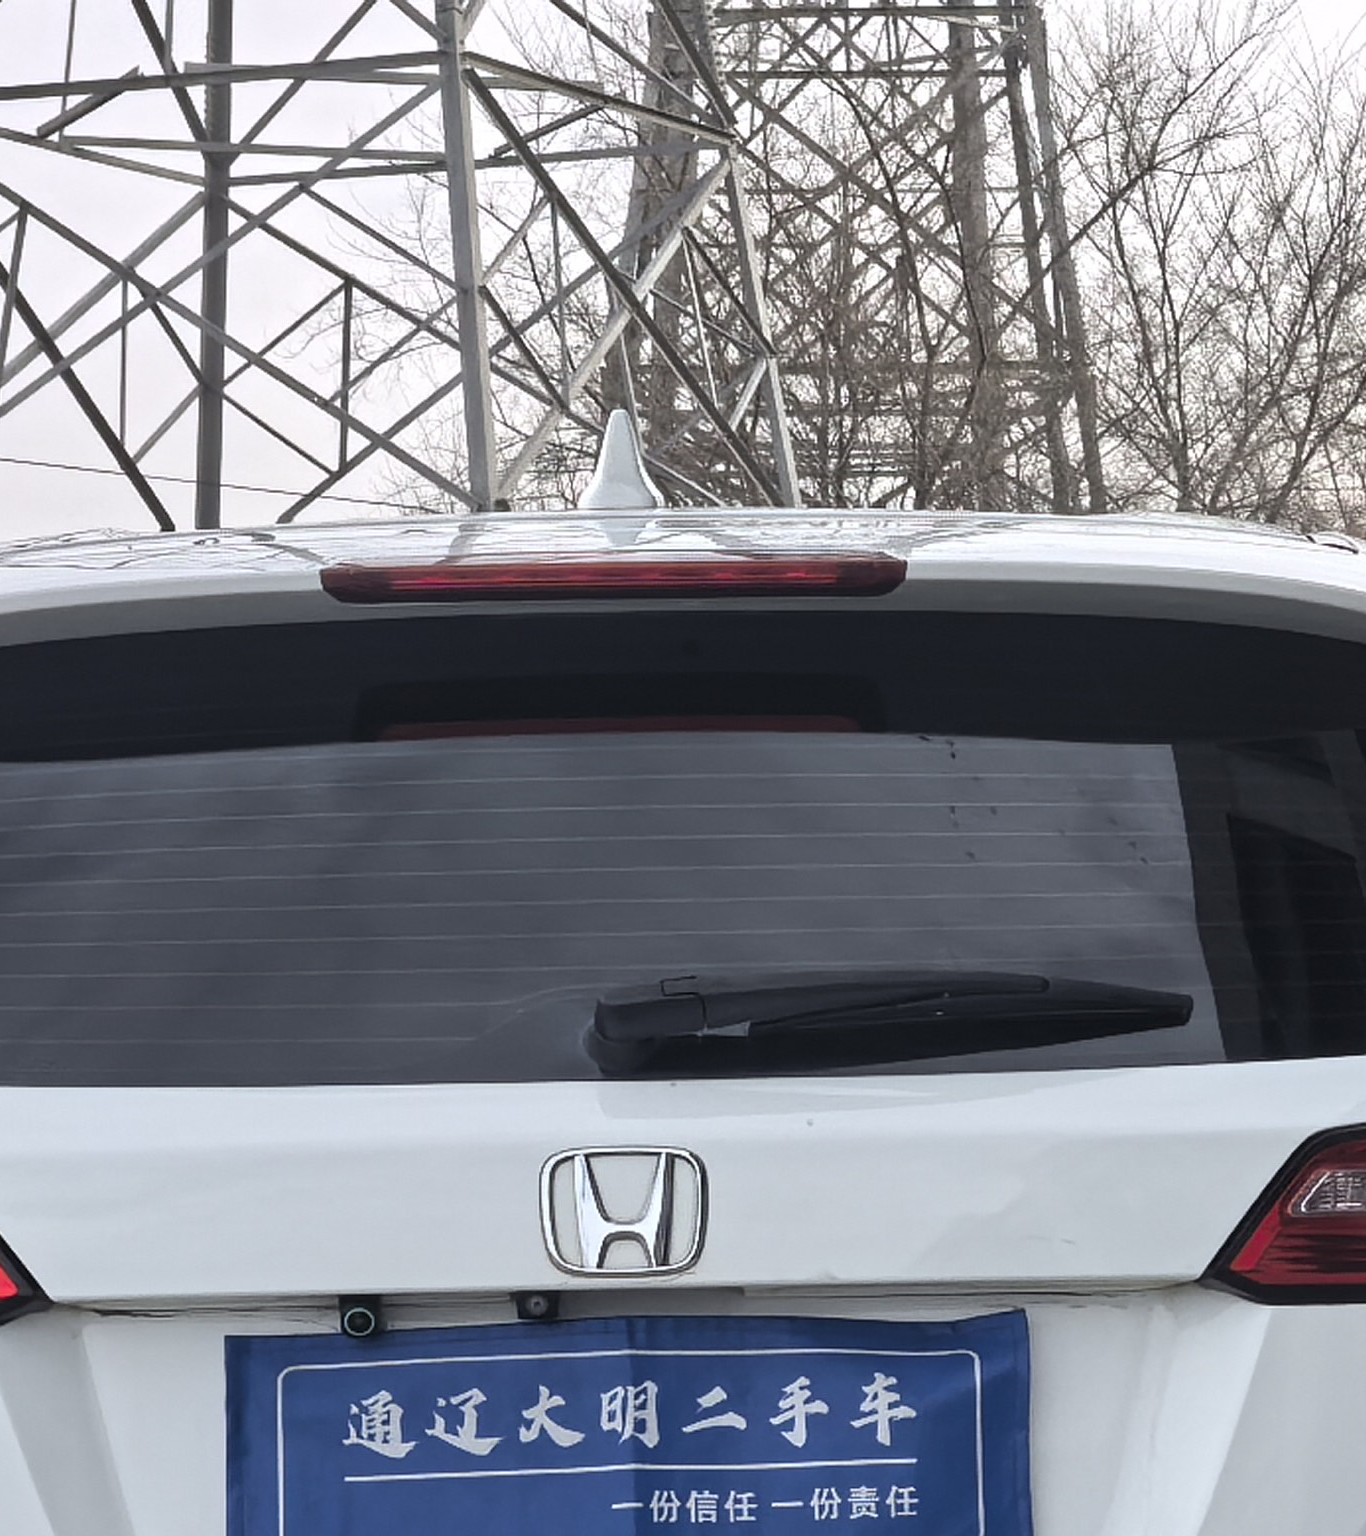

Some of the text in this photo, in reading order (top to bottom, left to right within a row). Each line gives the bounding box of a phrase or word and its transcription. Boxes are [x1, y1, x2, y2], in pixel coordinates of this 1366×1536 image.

[341, 1372, 919, 1459] 通辽大明二手车
[611, 1485, 921, 1525] 一份信任 一份责任
